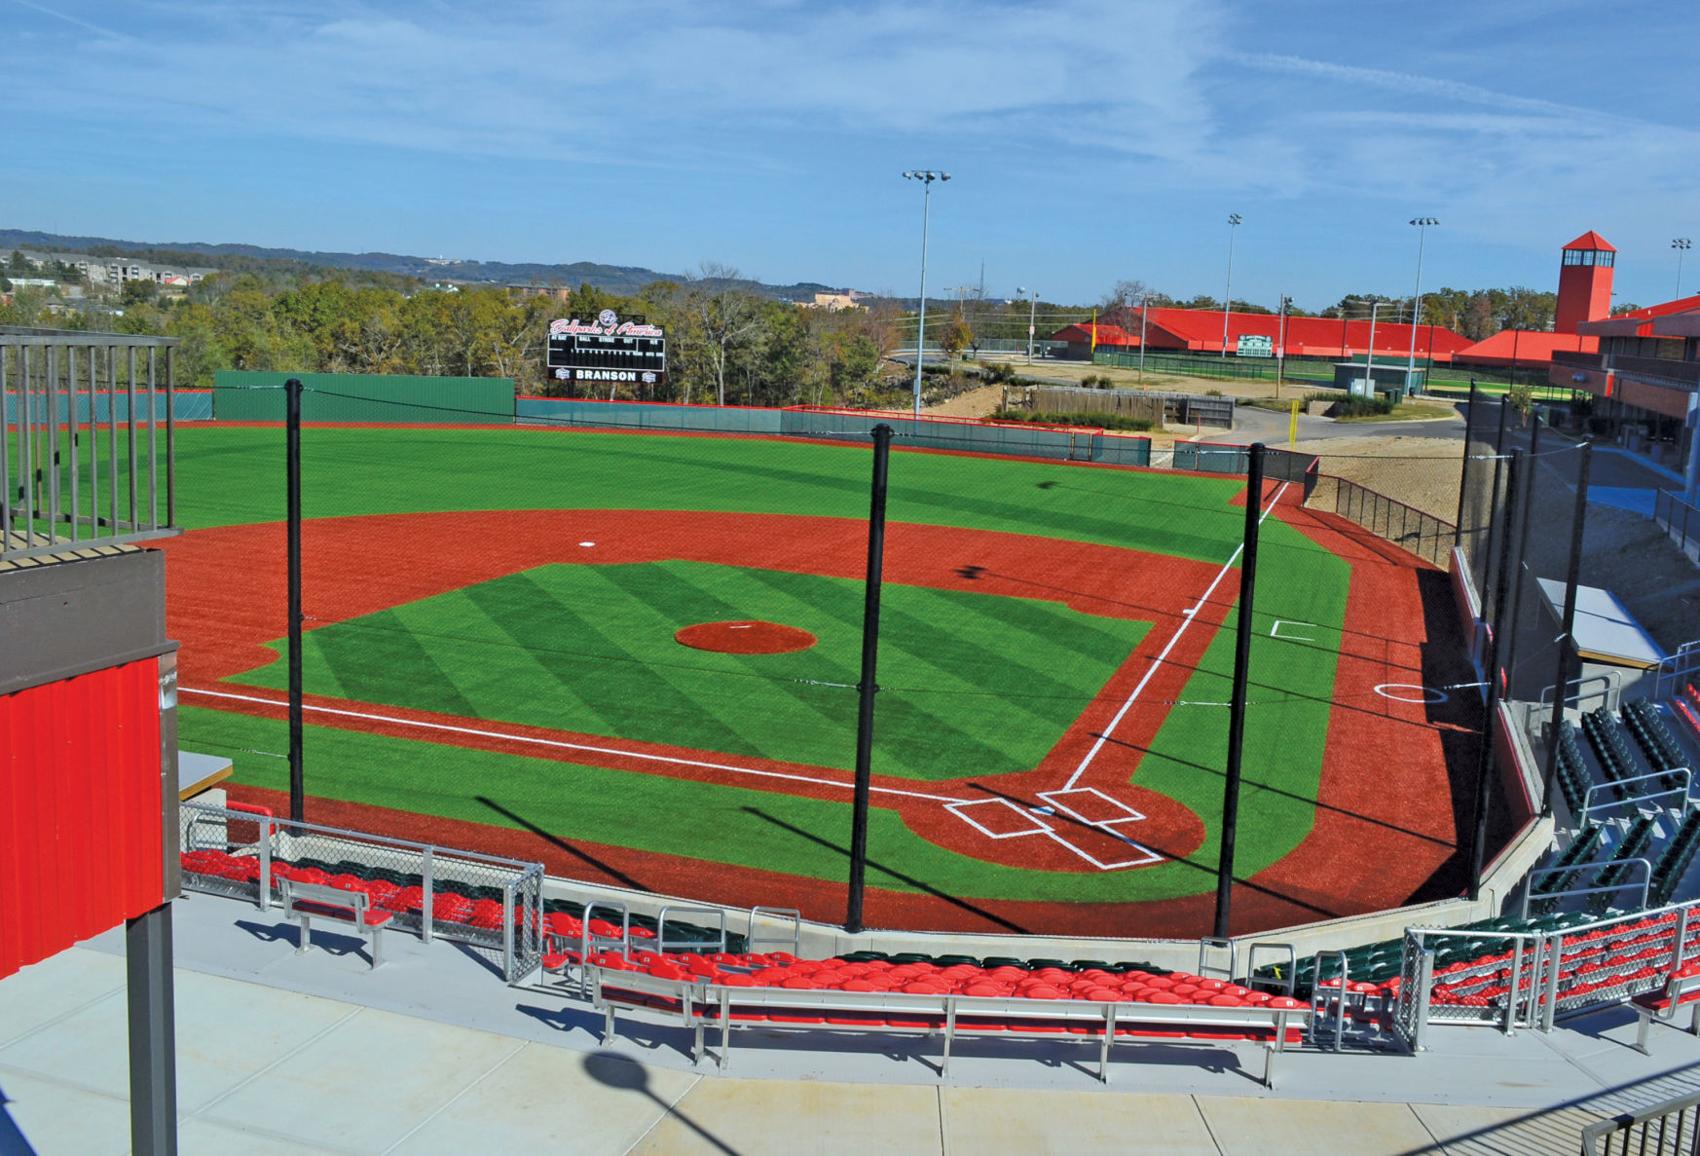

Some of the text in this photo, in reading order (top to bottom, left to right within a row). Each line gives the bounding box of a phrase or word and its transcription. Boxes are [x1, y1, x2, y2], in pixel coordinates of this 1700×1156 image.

[550, 319, 662, 336] Ballparks of America
[576, 370, 636, 381] BRANSON
